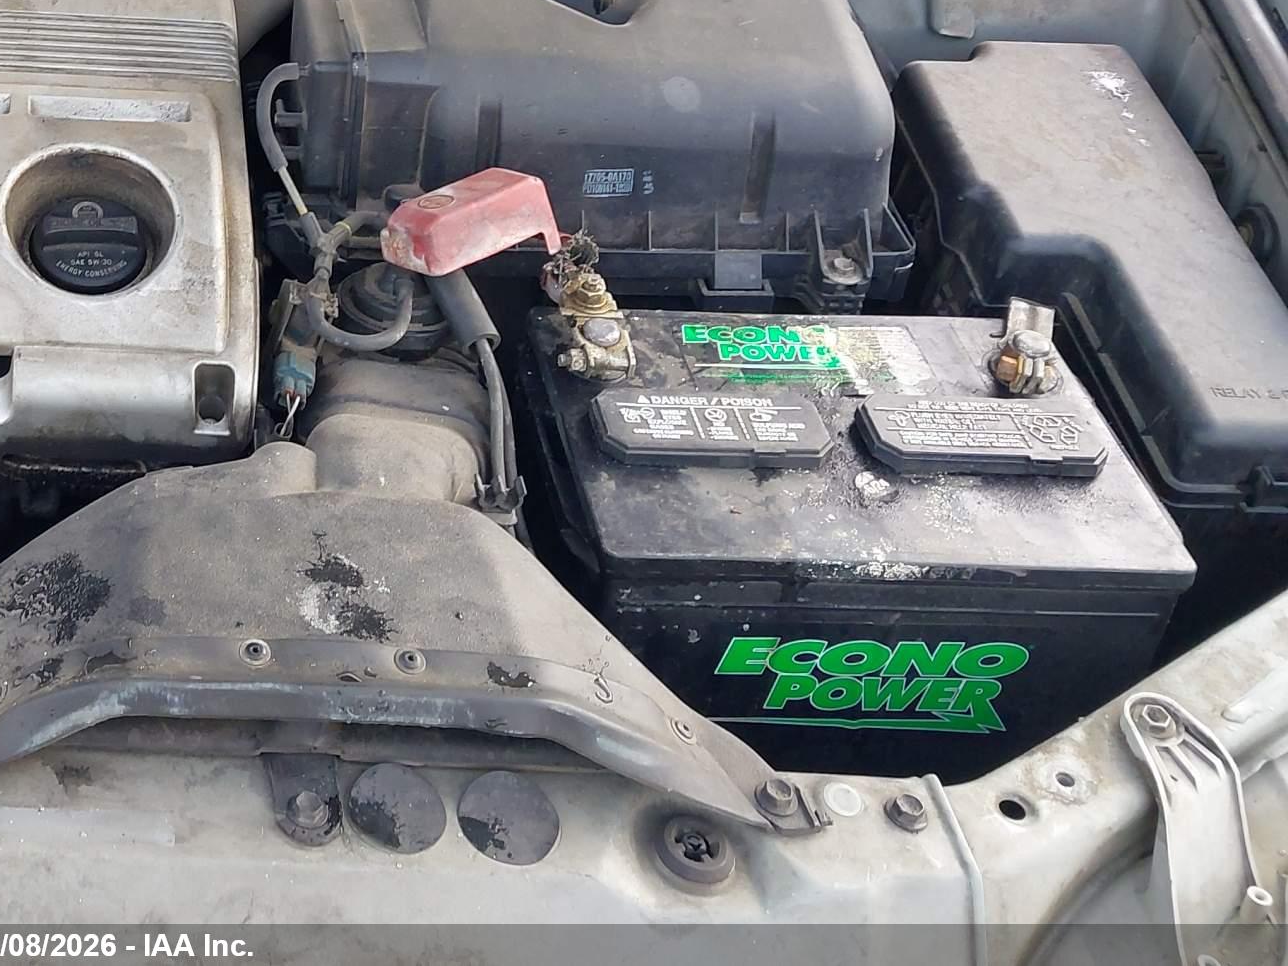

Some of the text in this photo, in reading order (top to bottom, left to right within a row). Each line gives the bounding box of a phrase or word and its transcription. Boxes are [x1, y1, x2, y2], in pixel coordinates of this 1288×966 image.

[650, 395, 709, 406] DANGER
[720, 397, 773, 407] POISON
[714, 637, 1029, 677] ECONO
[763, 674, 1007, 731] POWER
